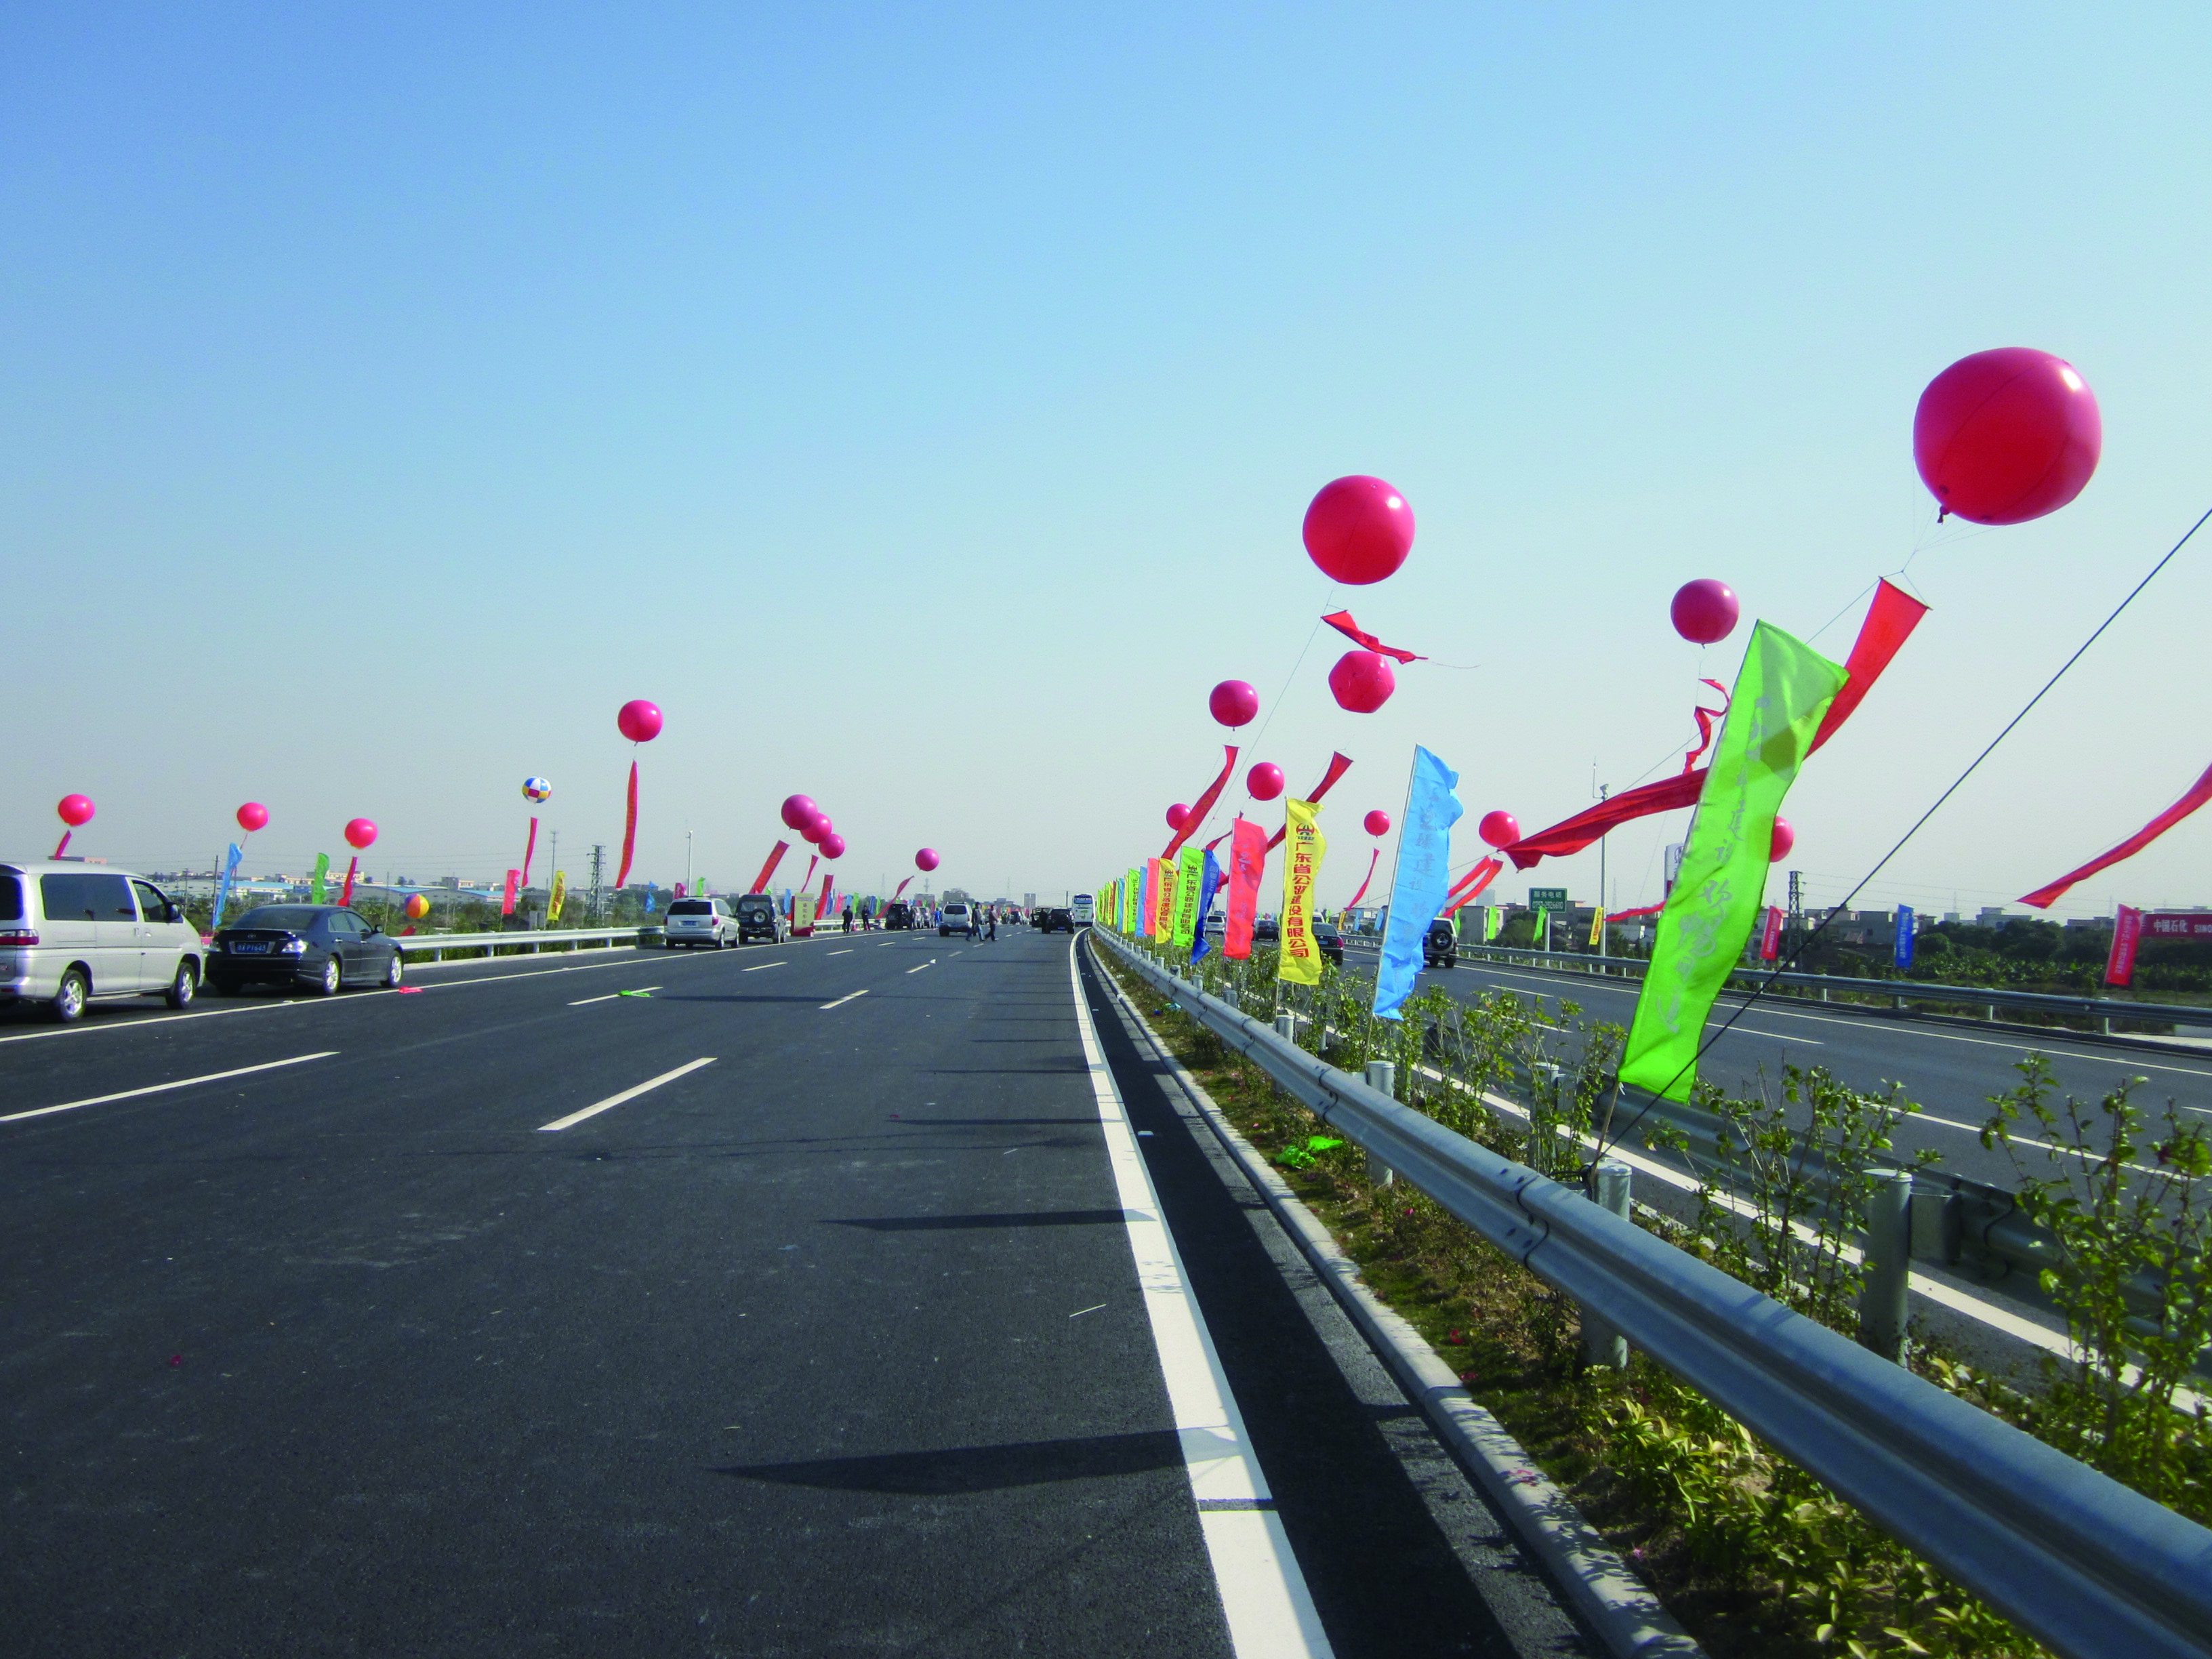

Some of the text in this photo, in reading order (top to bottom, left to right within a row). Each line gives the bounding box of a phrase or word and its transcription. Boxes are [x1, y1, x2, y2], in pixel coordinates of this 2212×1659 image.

[1288, 842, 1314, 958] 广东省公路建设有限公司
[2154, 919, 2188, 933] 中国石化
